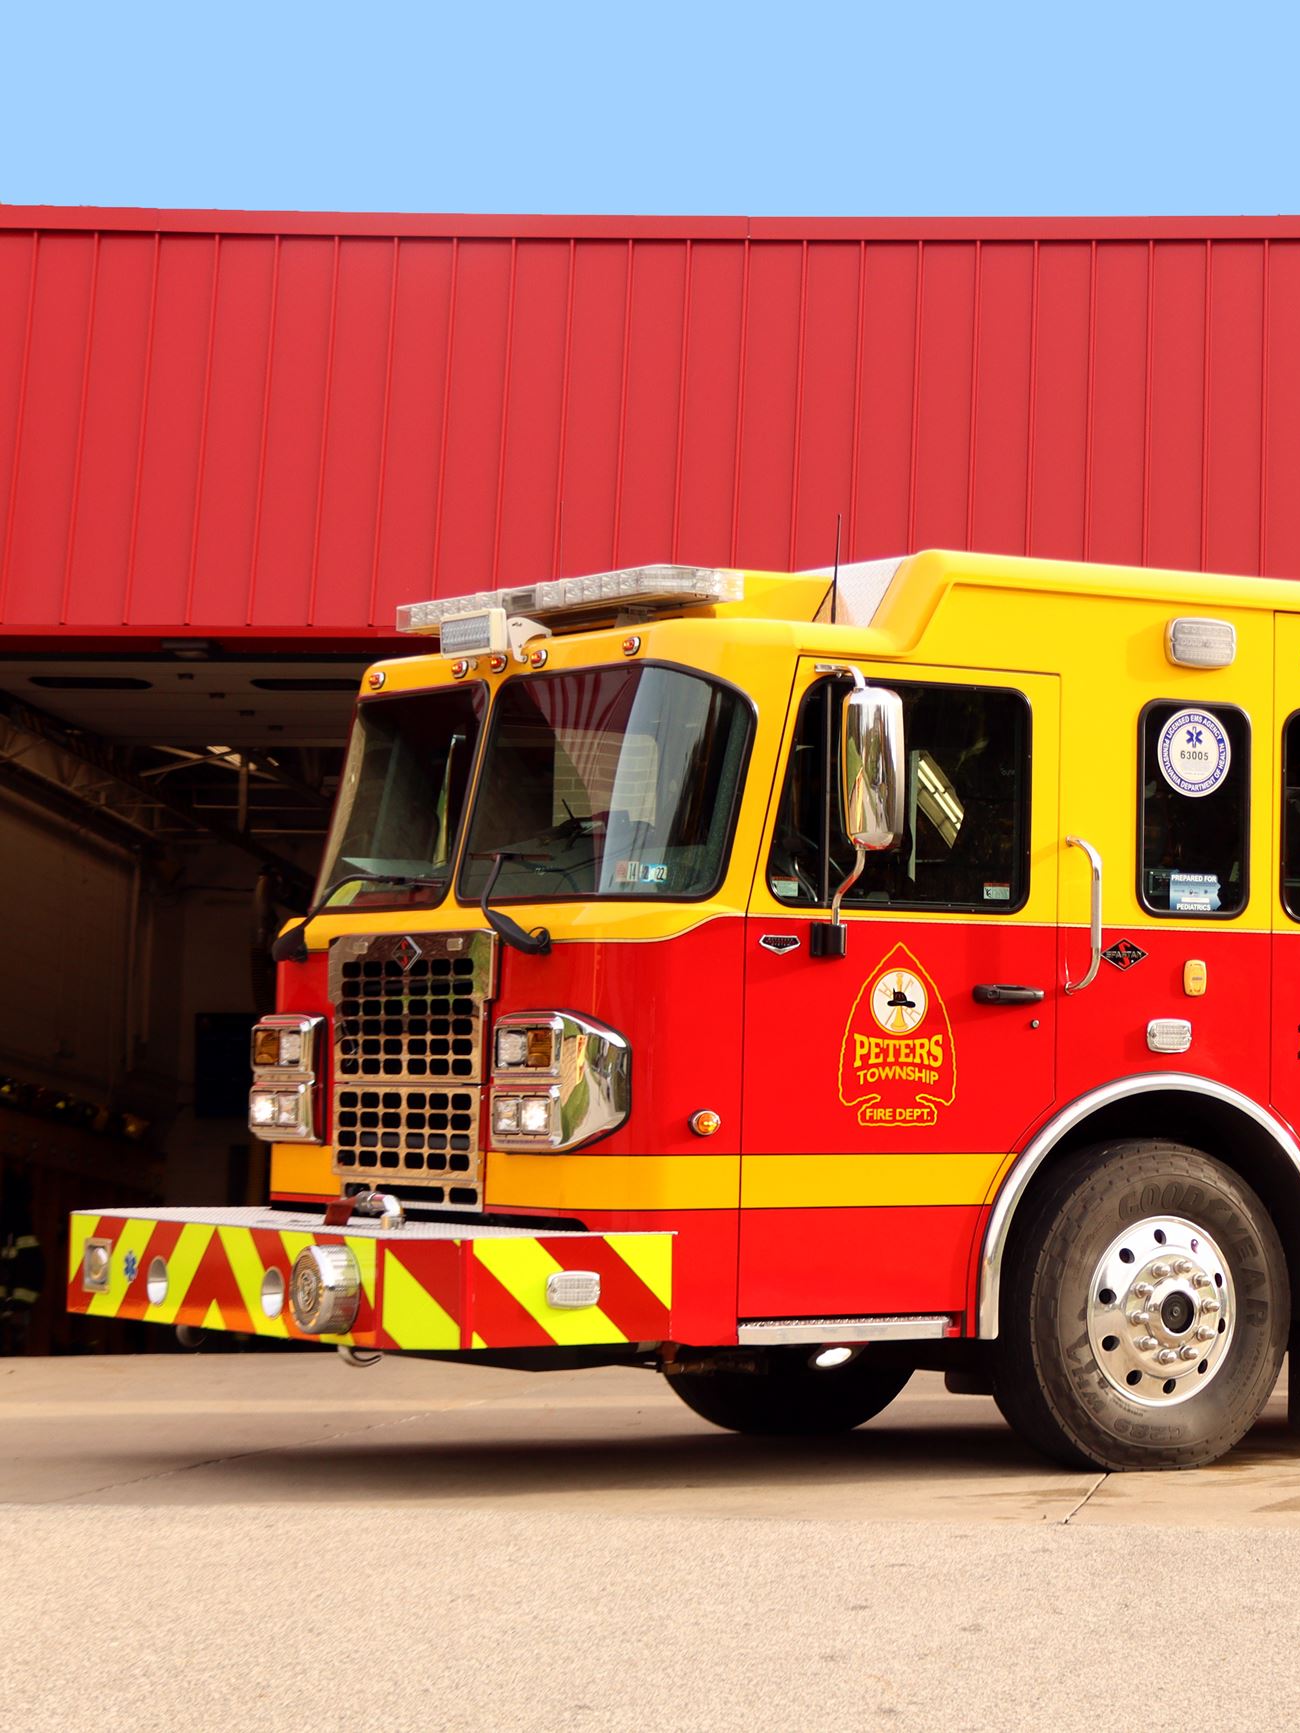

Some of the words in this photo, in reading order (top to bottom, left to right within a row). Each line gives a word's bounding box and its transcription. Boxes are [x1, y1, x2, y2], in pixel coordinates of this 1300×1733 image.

[1166, 715, 1190, 739] LICENSED
[1190, 714, 1203, 723] EMS
[1202, 719, 1222, 740] AGENCY
[1180, 750, 1209, 761] 63005
[1181, 779, 1216, 792] DEPARTMENT
[1215, 769, 1221, 778] OF
[1218, 742, 1226, 769] HEALTH
[1171, 874, 1204, 882] PREPARED
[1176, 903, 1211, 911] PEDIATRICS
[853, 1033, 943, 1068] PETERS
[856, 1065, 939, 1085] TOWNSHIP
[865, 1108, 893, 1120] FIRE
[896, 1108, 931, 1120] DEPT.
[1119, 1181, 1270, 1327] GOODYEAR
